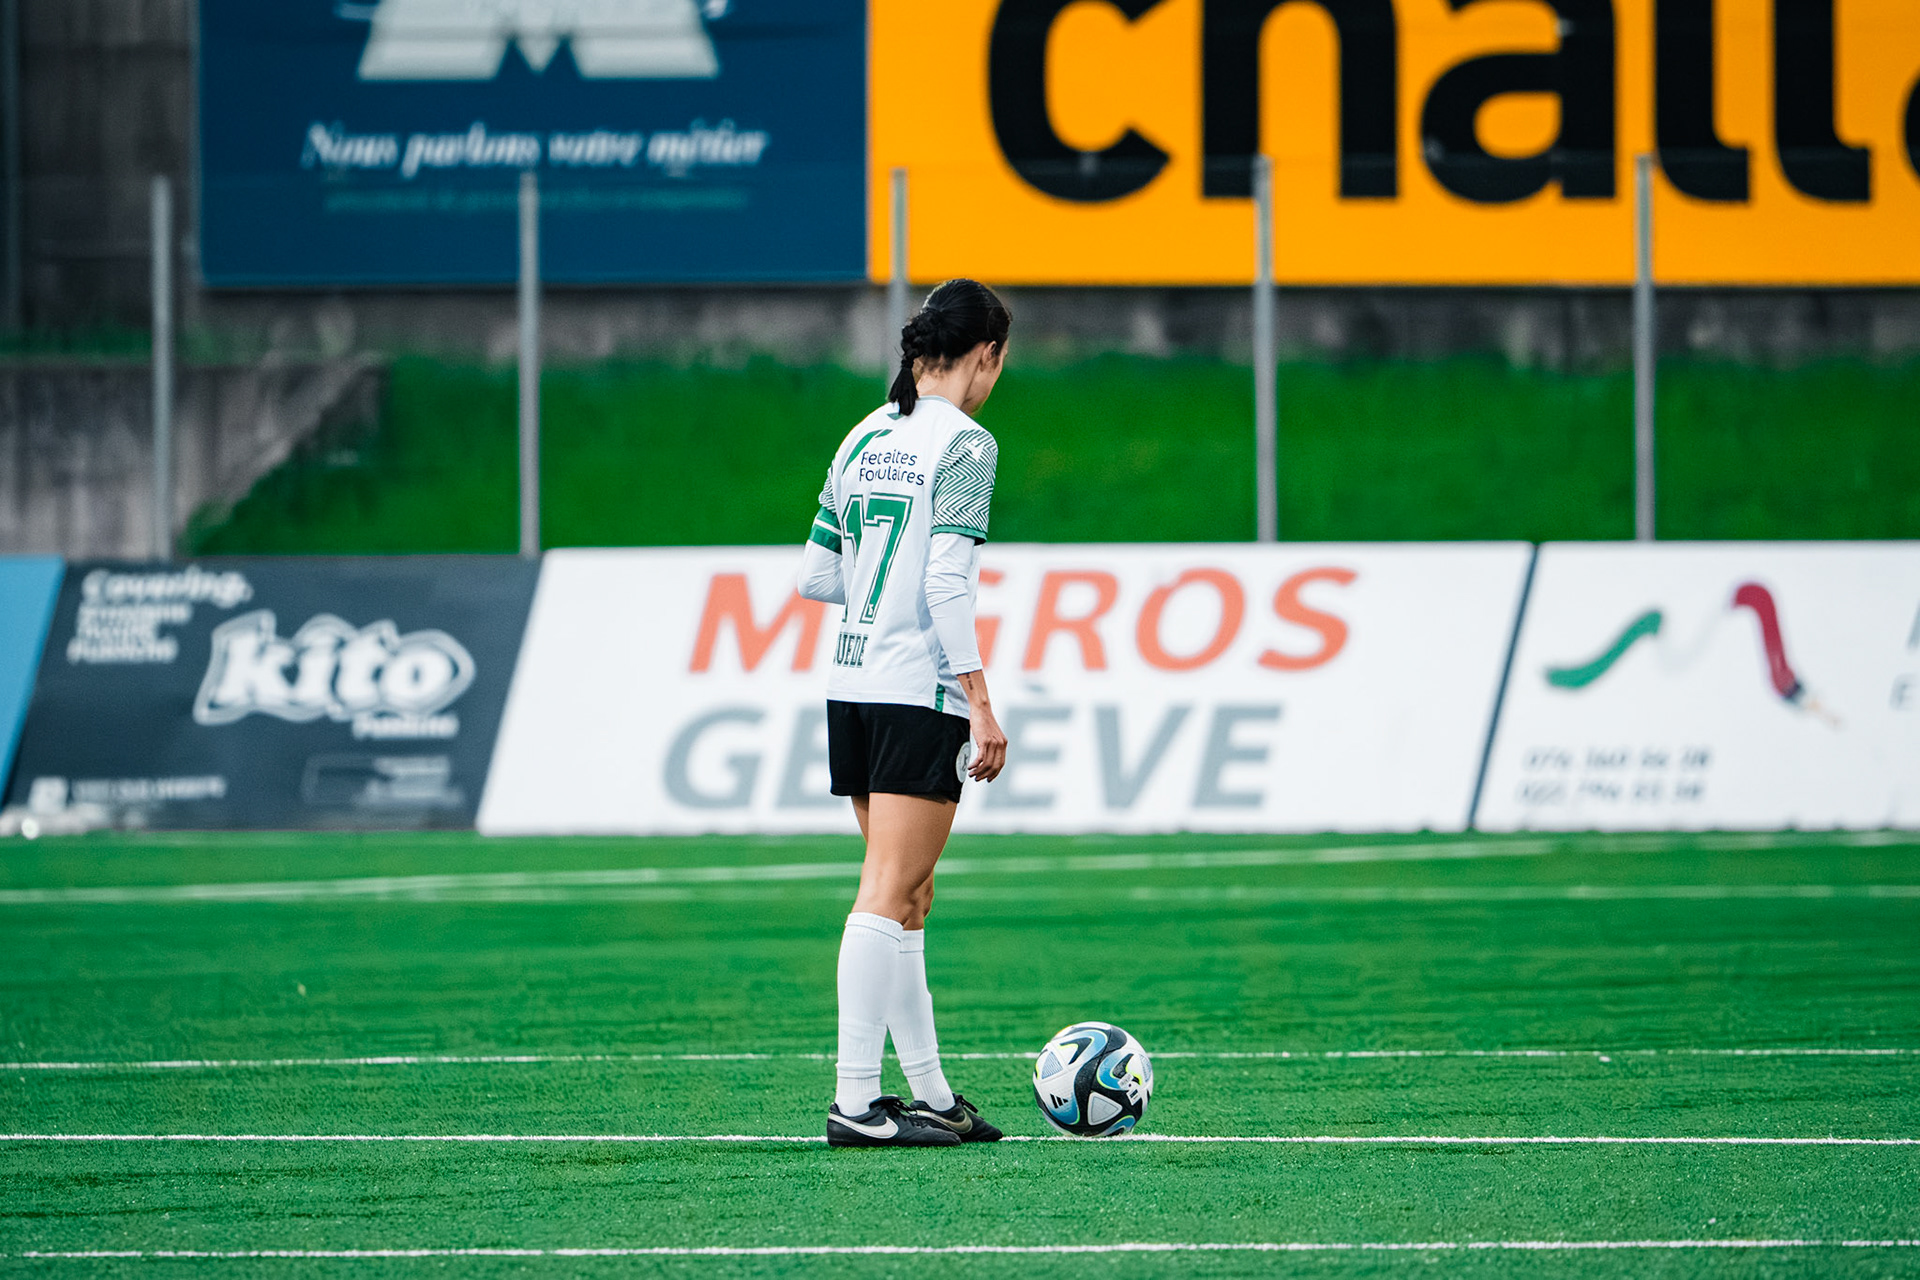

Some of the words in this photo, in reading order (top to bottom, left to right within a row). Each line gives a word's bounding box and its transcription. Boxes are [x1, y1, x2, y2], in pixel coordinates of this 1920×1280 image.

[302, 121, 399, 168] Nous
[402, 121, 541, 178] parlons
[549, 130, 642, 167] votre
[988, 0, 1920, 203] chall
[842, 492, 914, 624] 17
[206, 618, 463, 713] kito
[689, 567, 1359, 673] MROS
[833, 632, 869, 668] UEDE
[661, 680, 1284, 811] GEÈVE
